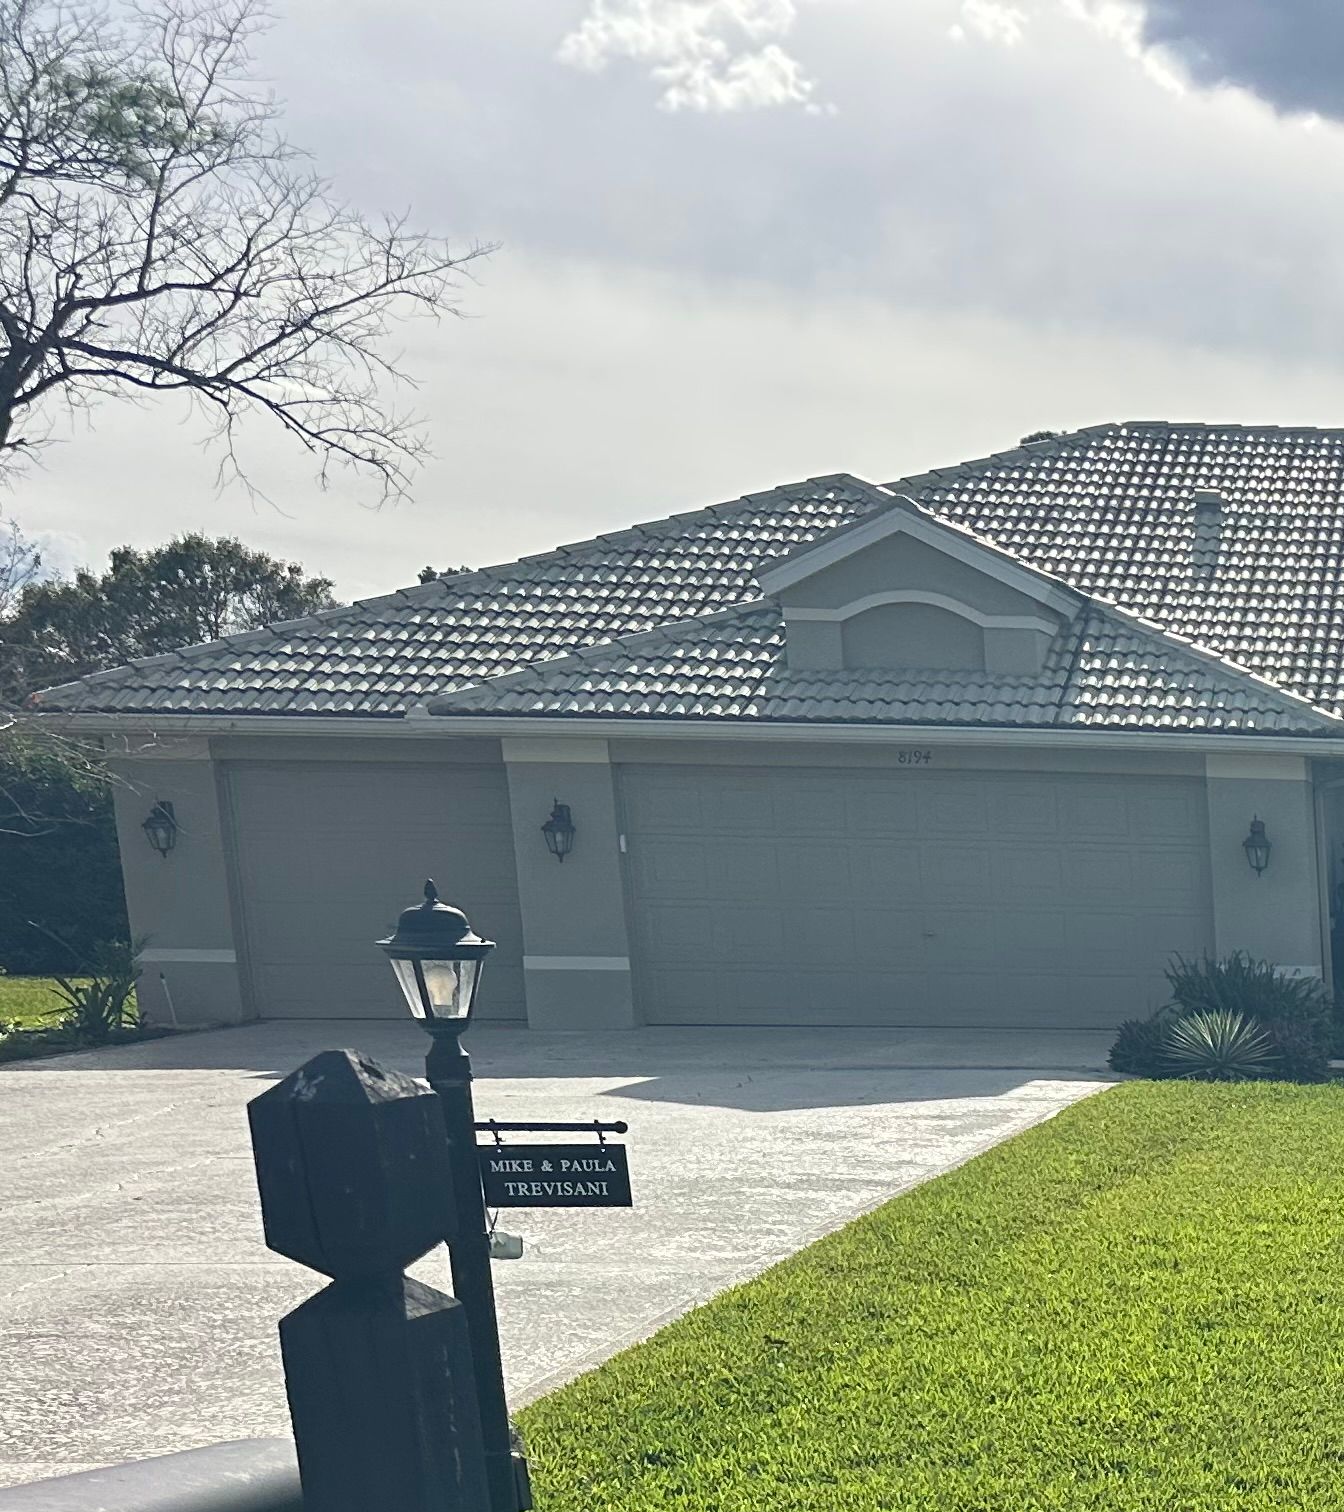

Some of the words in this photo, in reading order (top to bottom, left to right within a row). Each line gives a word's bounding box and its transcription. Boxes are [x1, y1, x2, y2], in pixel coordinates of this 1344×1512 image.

[898, 750, 932, 765] 8194
[490, 1160, 533, 1172] MIKE
[540, 1160, 553, 1172] &
[560, 1159, 616, 1172] PAULA
[504, 1181, 609, 1196] TREVISANI
